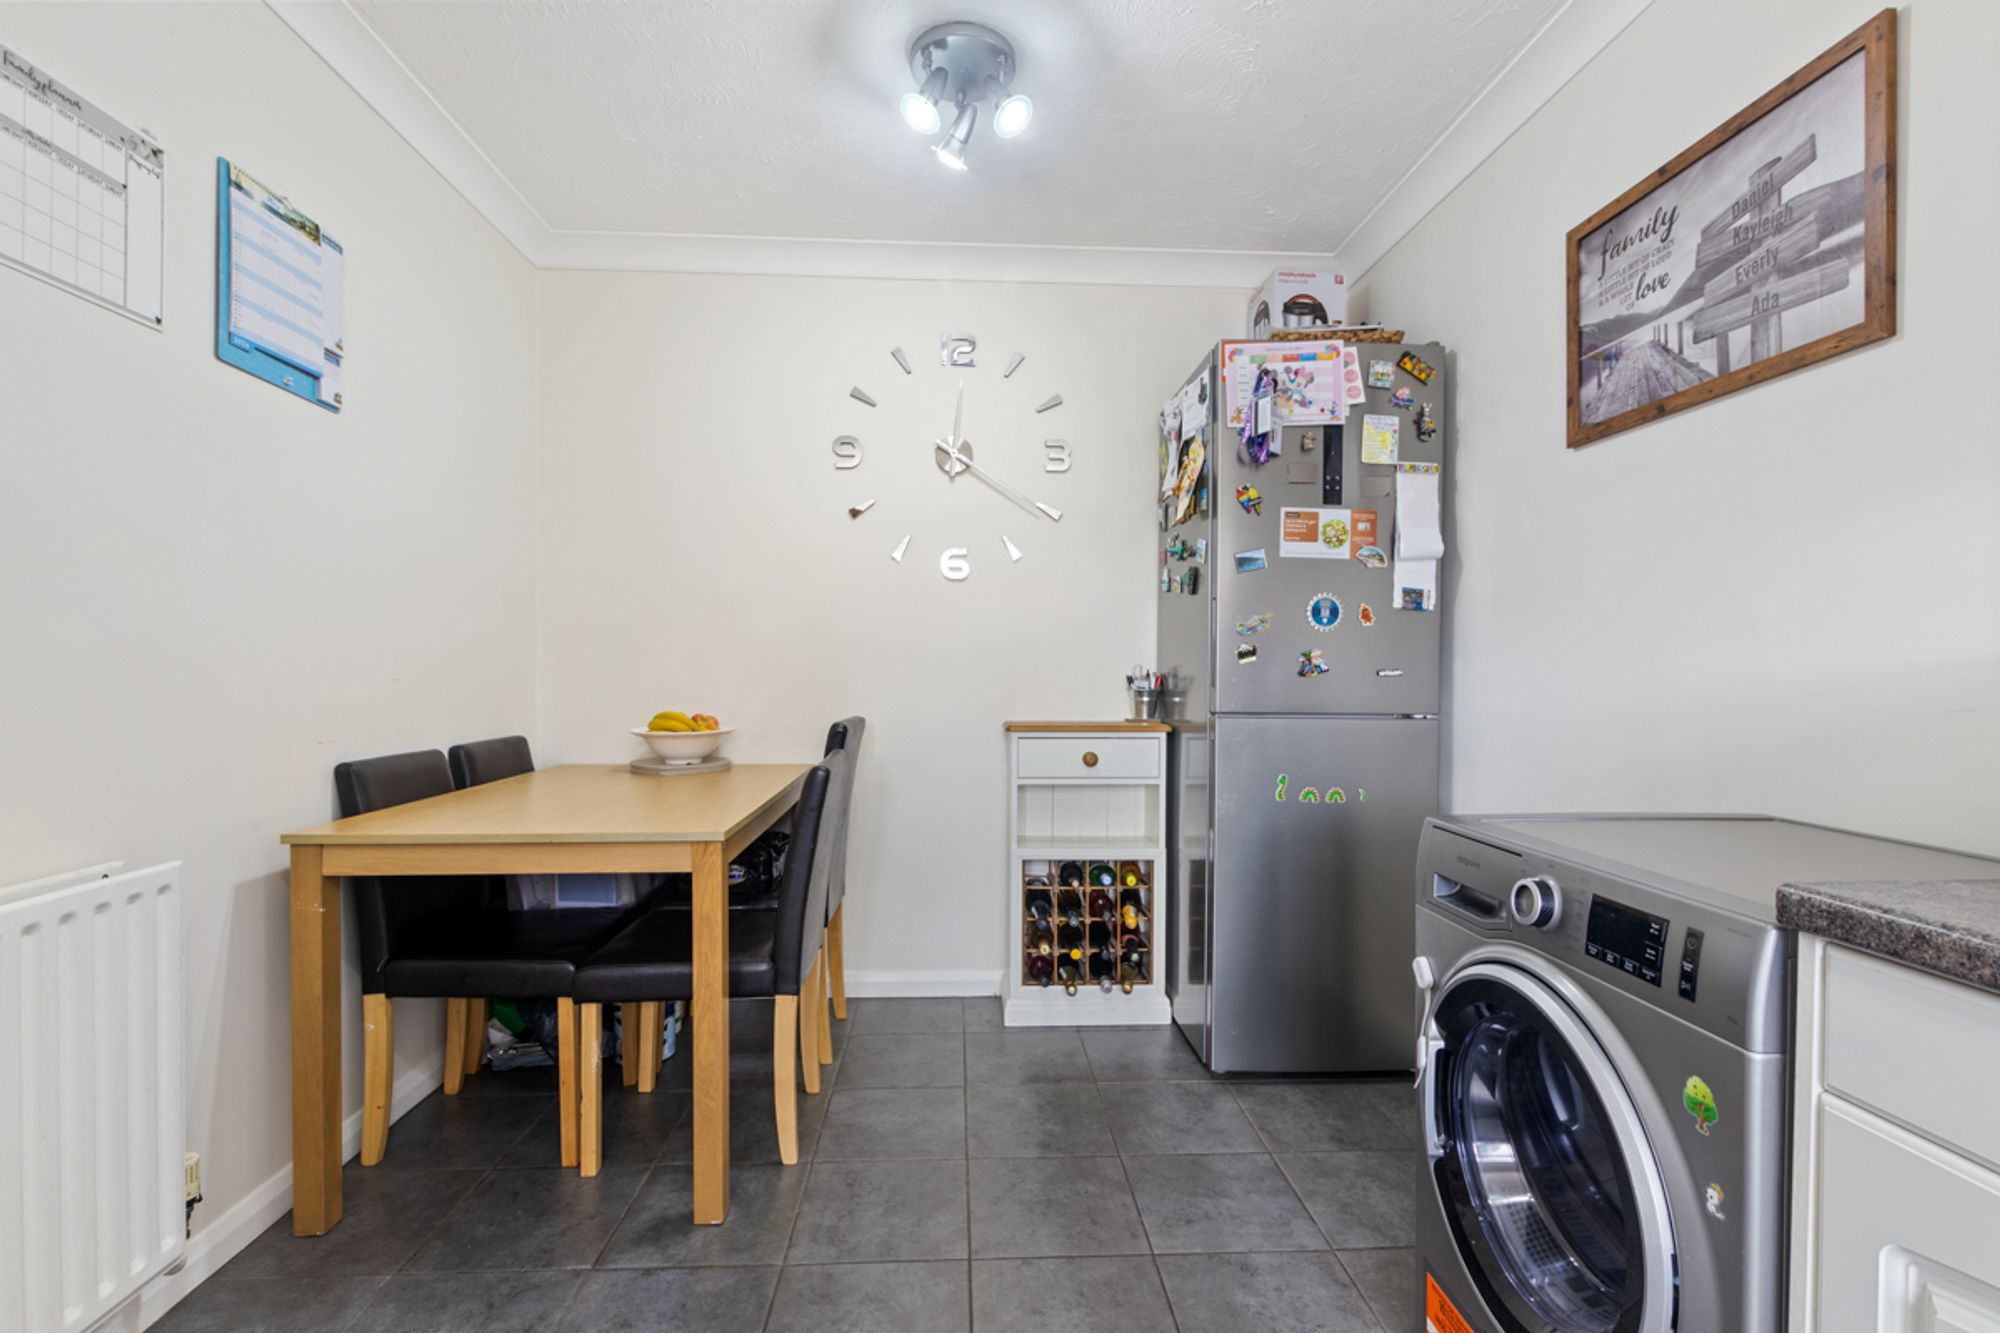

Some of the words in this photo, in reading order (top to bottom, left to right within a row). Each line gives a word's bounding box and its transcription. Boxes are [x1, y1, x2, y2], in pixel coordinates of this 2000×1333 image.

[1732, 172, 1774, 220] Daniel
[1733, 202, 1793, 246] Kayleigh
[1597, 206, 1681, 281] family
[1735, 247, 1779, 284] Everly
[1636, 272, 1671, 301] love
[1751, 291, 1780, 317] Ada
[940, 332, 976, 367] 12
[832, 434, 864, 470] 9
[1044, 439, 1073, 473] 3
[939, 547, 970, 581] 6
